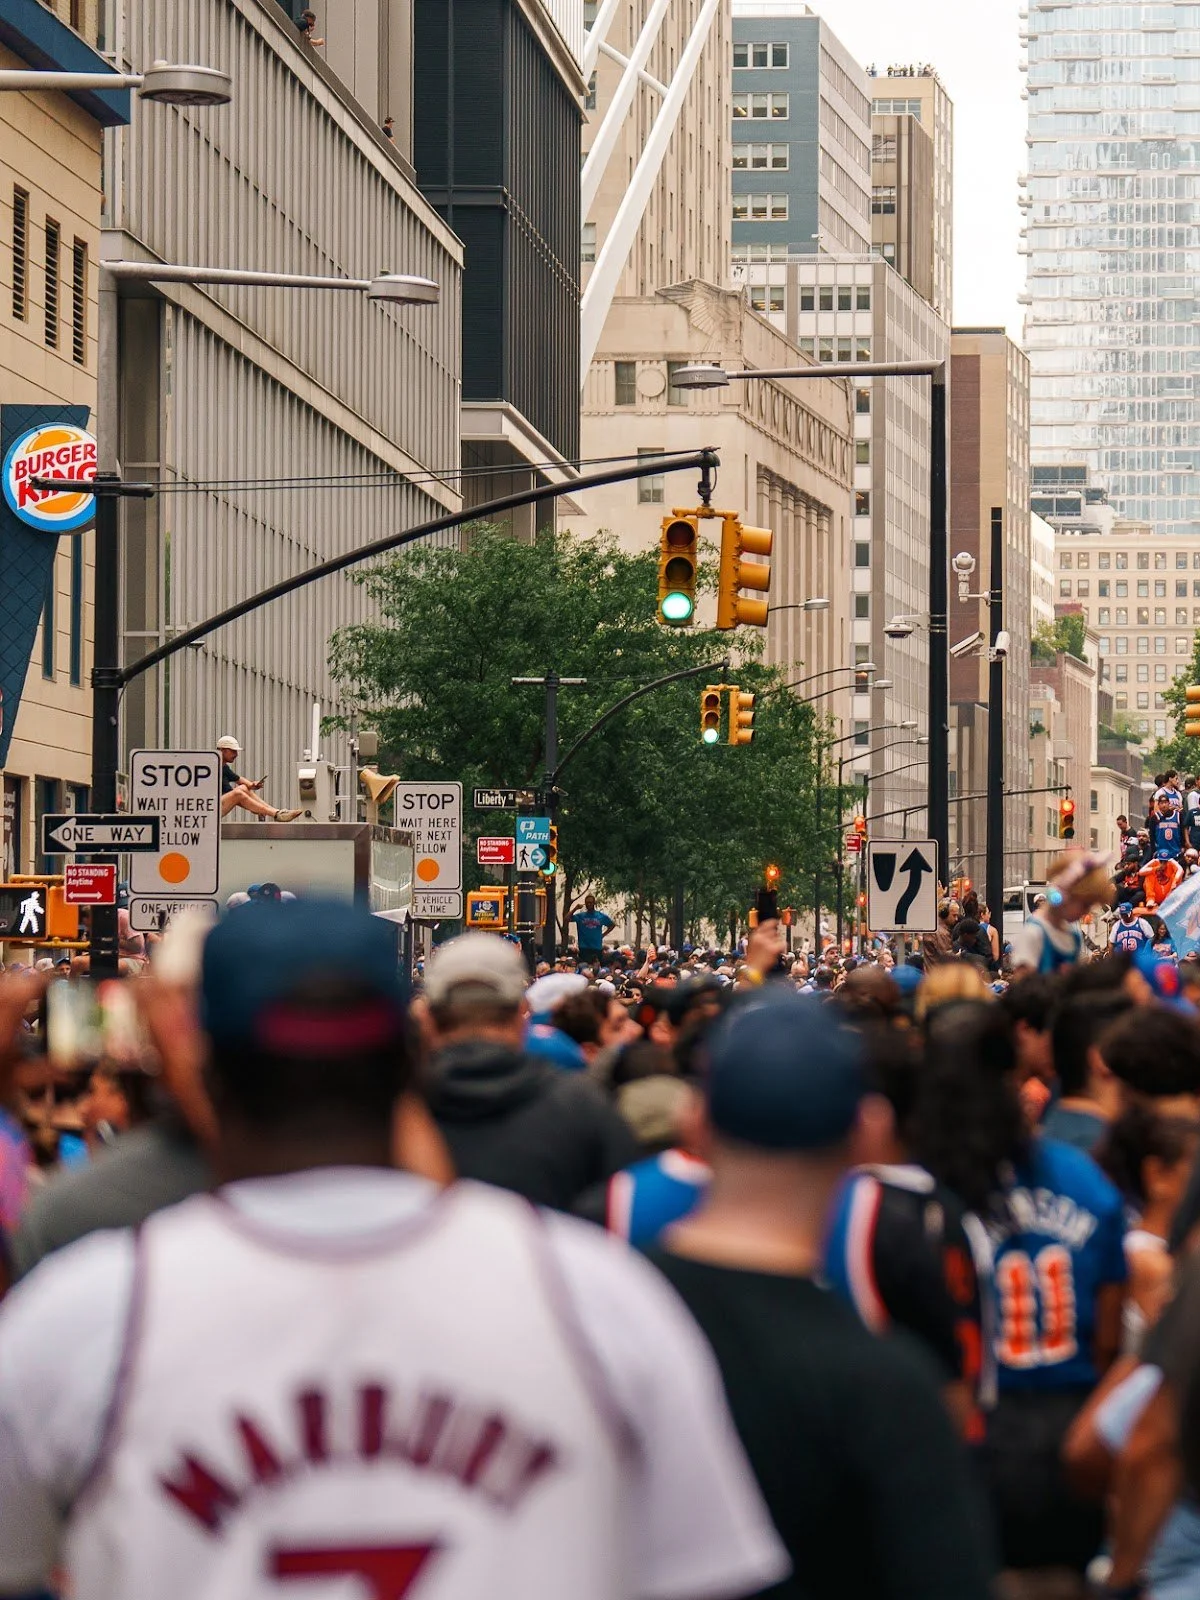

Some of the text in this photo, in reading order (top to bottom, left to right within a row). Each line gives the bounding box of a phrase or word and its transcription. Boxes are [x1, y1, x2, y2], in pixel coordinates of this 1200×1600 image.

[14, 443, 97, 481] BURGER
[141, 765, 212, 787] STOP
[136, 797, 215, 812] WAIT HERE
[402, 793, 455, 810] STOP
[477, 792, 507, 807] Liberty
[174, 815, 208, 829] NEXT
[400, 818, 457, 828] WAIT HERE
[61, 827, 145, 842] ONE WAY
[161, 832, 200, 846] ELLOW
[427, 830, 452, 840] NEXT
[525, 832, 549, 840] PATH
[416, 843, 447, 853] ELLOW
[67, 868, 109, 877] NO STANDING
[67, 878, 93, 887] Anytime
[422, 896, 453, 904] VEHICLE
[141, 903, 160, 914] ONE
[1122, 937, 1137, 951] 13
[996, 1244, 1078, 1369] 11
